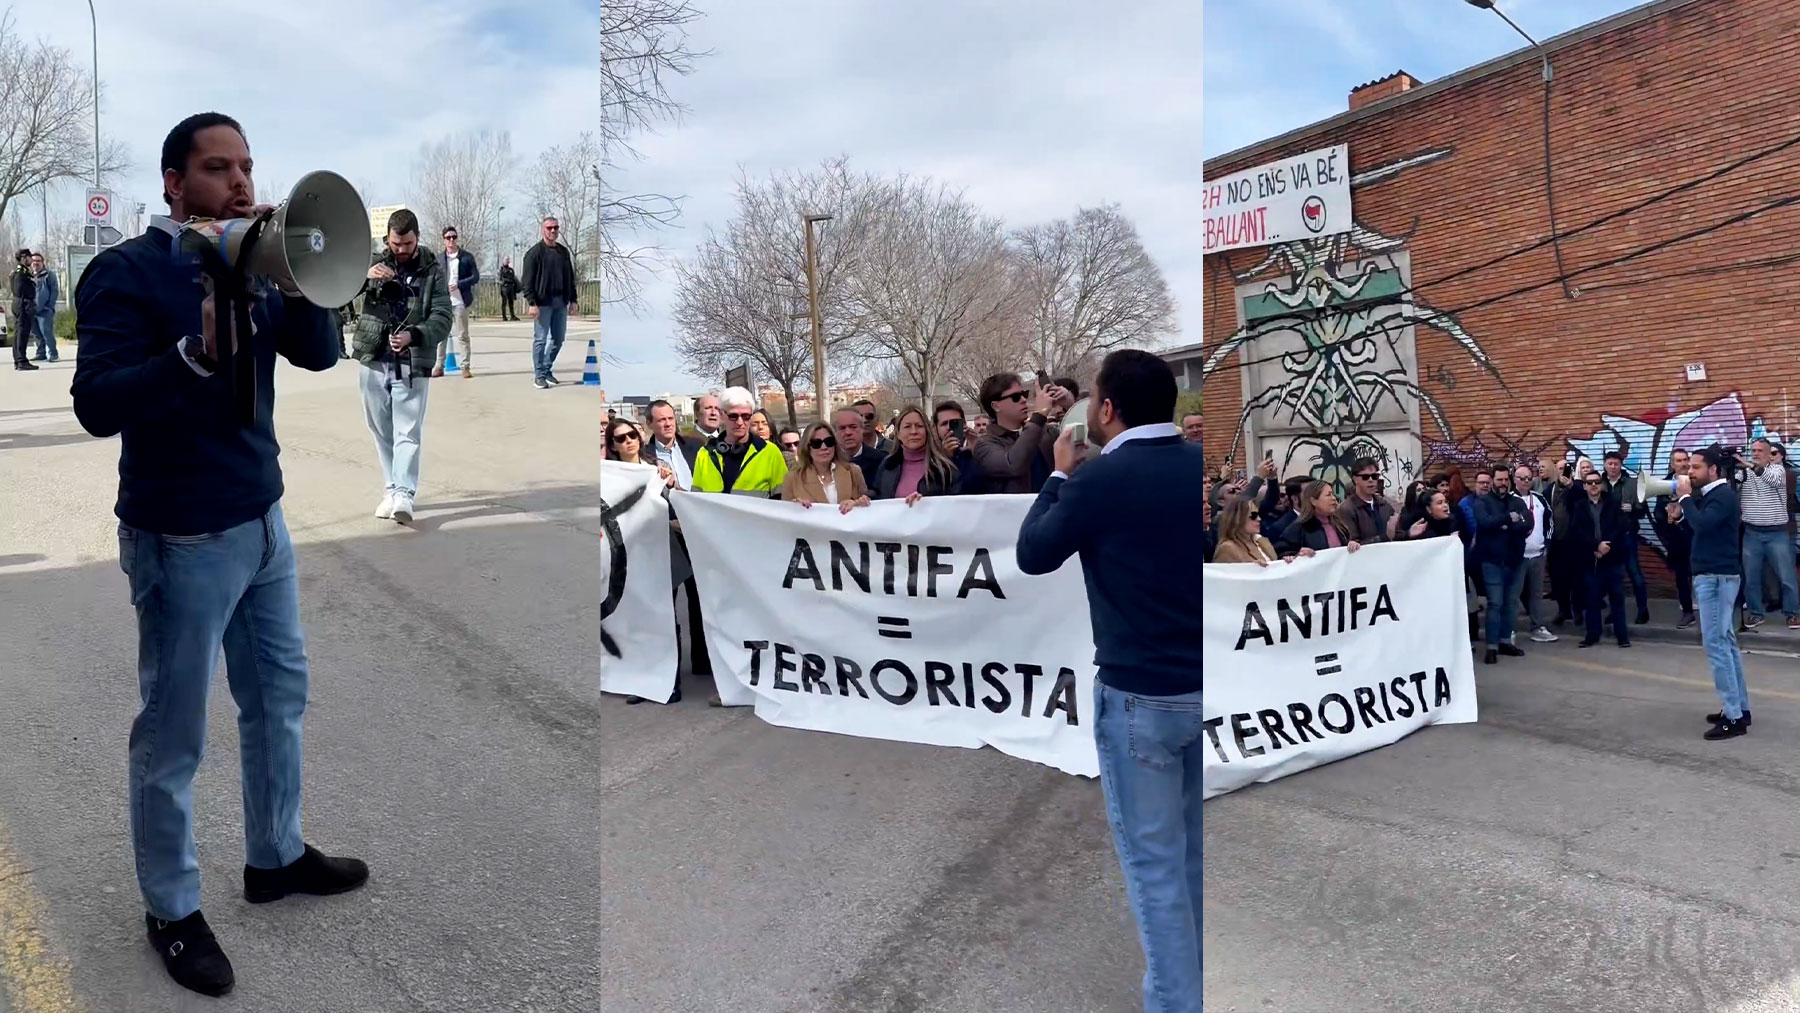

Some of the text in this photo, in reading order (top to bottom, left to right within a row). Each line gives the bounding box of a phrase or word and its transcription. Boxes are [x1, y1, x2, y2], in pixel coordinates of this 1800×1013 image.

[1227, 179, 1252, 205] NO
[1258, 169, 1286, 199] ENS
[1291, 163, 1312, 190] VA
[1316, 148, 1343, 186] BÉ,
[782, 538, 1007, 599] ANTIFA
[877, 615, 912, 639] =
[1234, 584, 1400, 651] ANTIFA
[743, 640, 1079, 726] TERRORISTA
[1314, 652, 1342, 676] =
[1203, 667, 1451, 763] TERRORISTA
